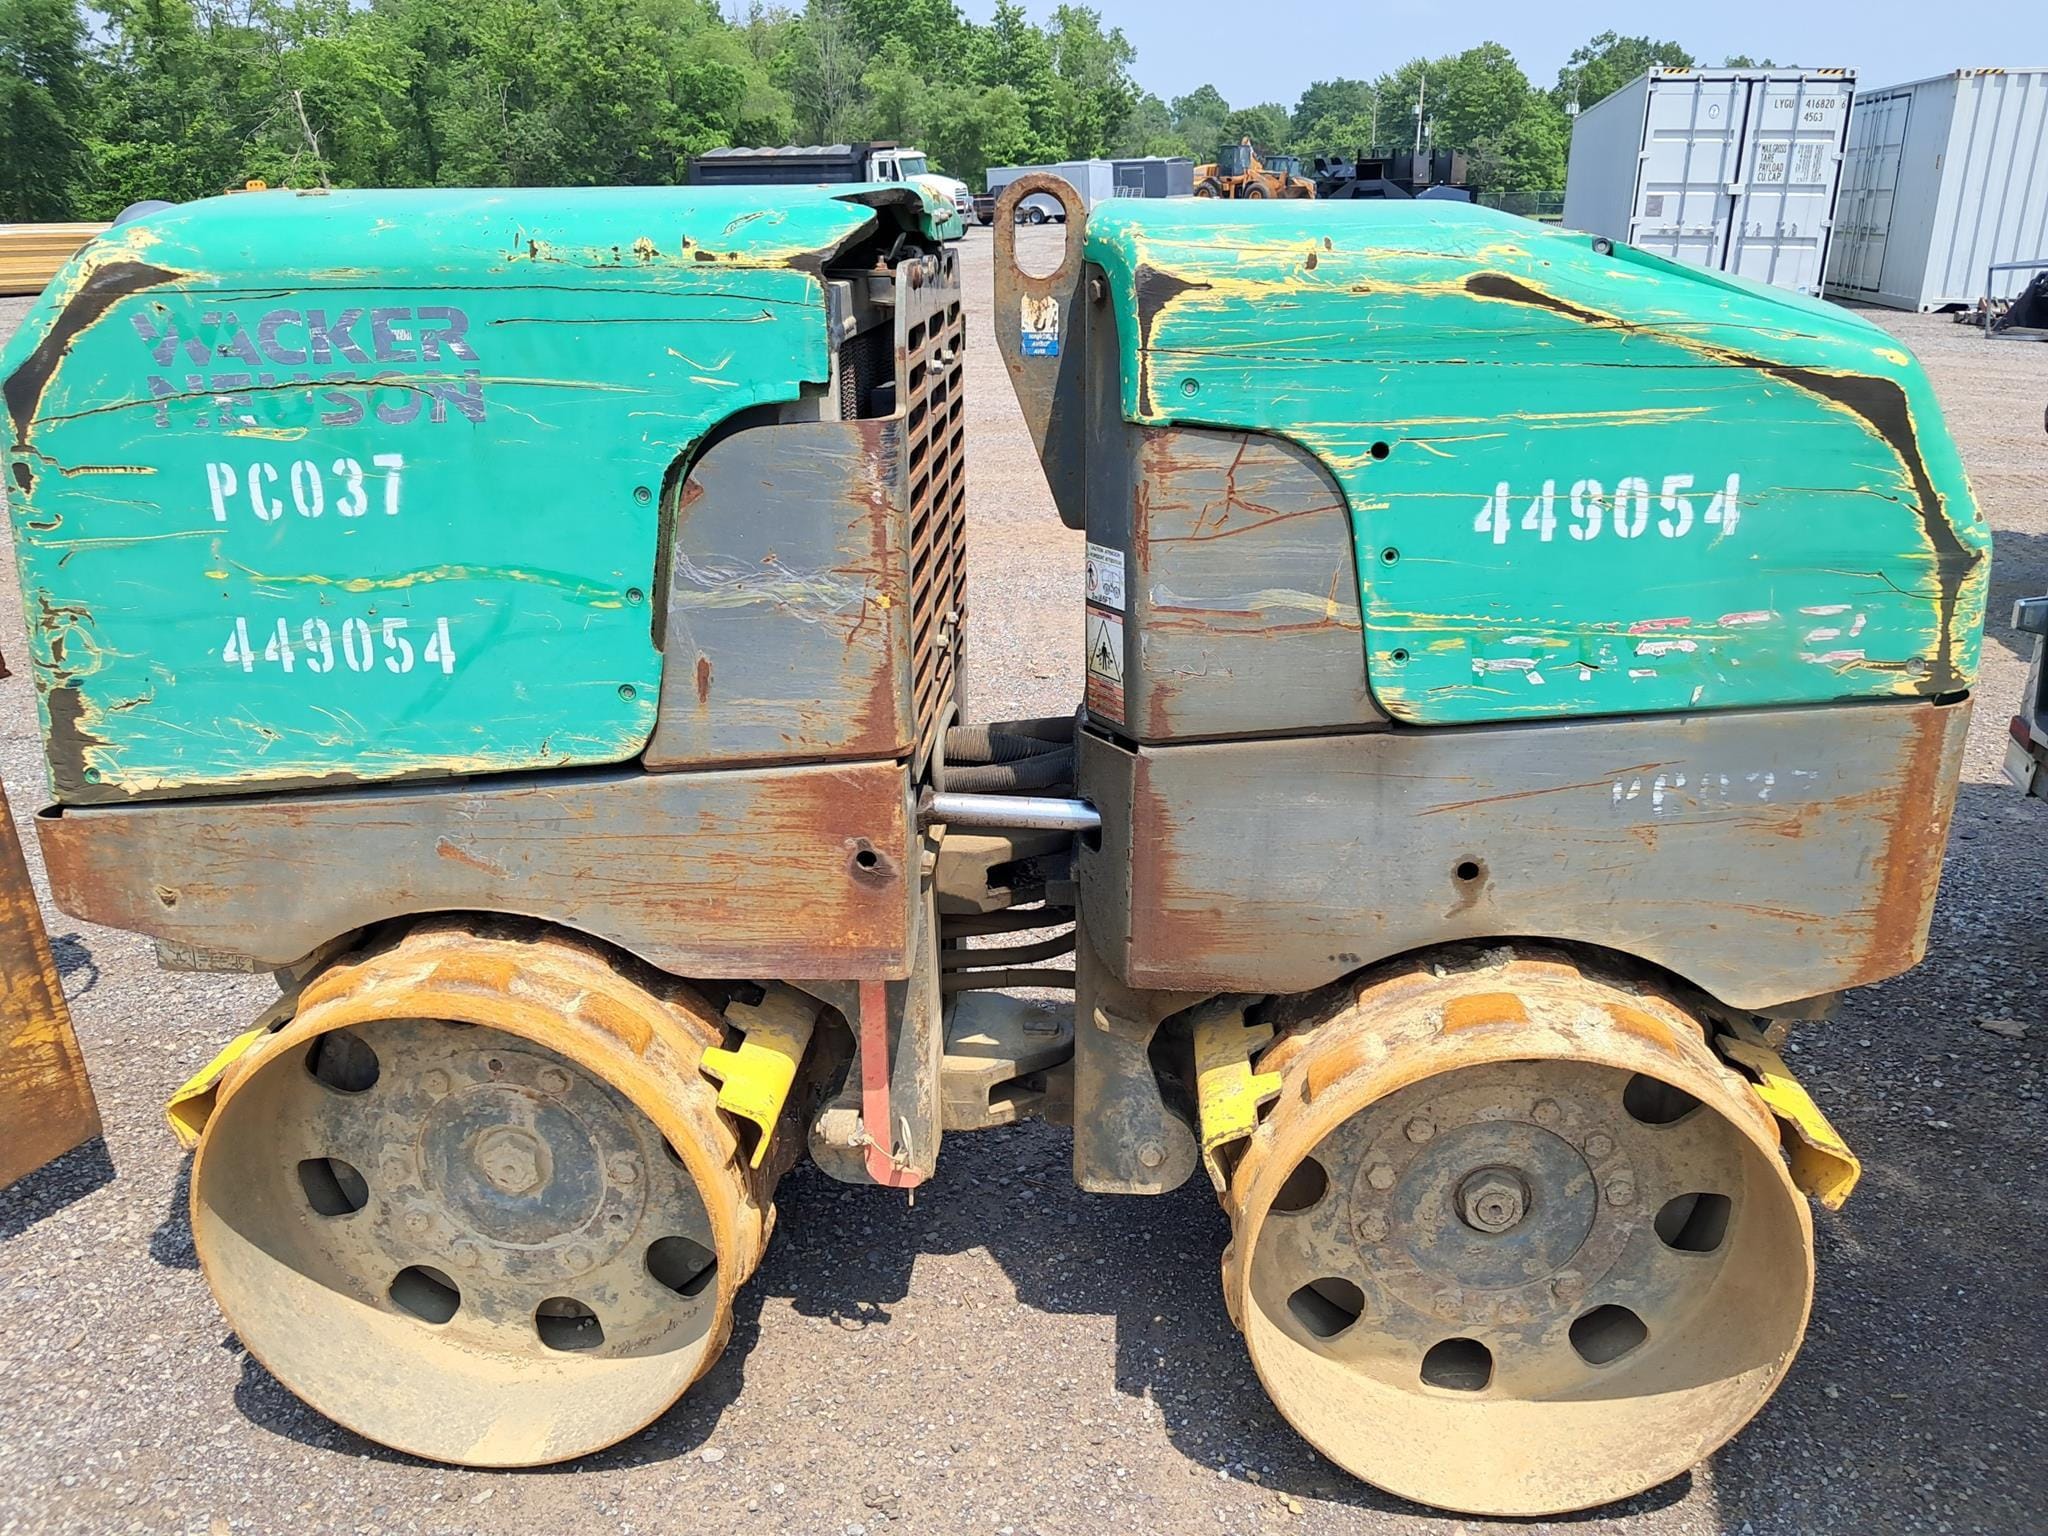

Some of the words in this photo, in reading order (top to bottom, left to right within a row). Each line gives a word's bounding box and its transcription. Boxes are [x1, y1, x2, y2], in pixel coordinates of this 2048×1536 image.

[1774, 98, 1794, 109] LYGU
[1805, 99, 1835, 109] 416820
[1803, 112, 1824, 122] 45G3
[1758, 162, 1784, 172] PAYLOAD
[1760, 153, 1775, 163] TARE
[130, 306, 481, 368] WACKER
[205, 453, 404, 523] PC037
[1473, 472, 1741, 545] 449054
[221, 616, 457, 675] 449054
